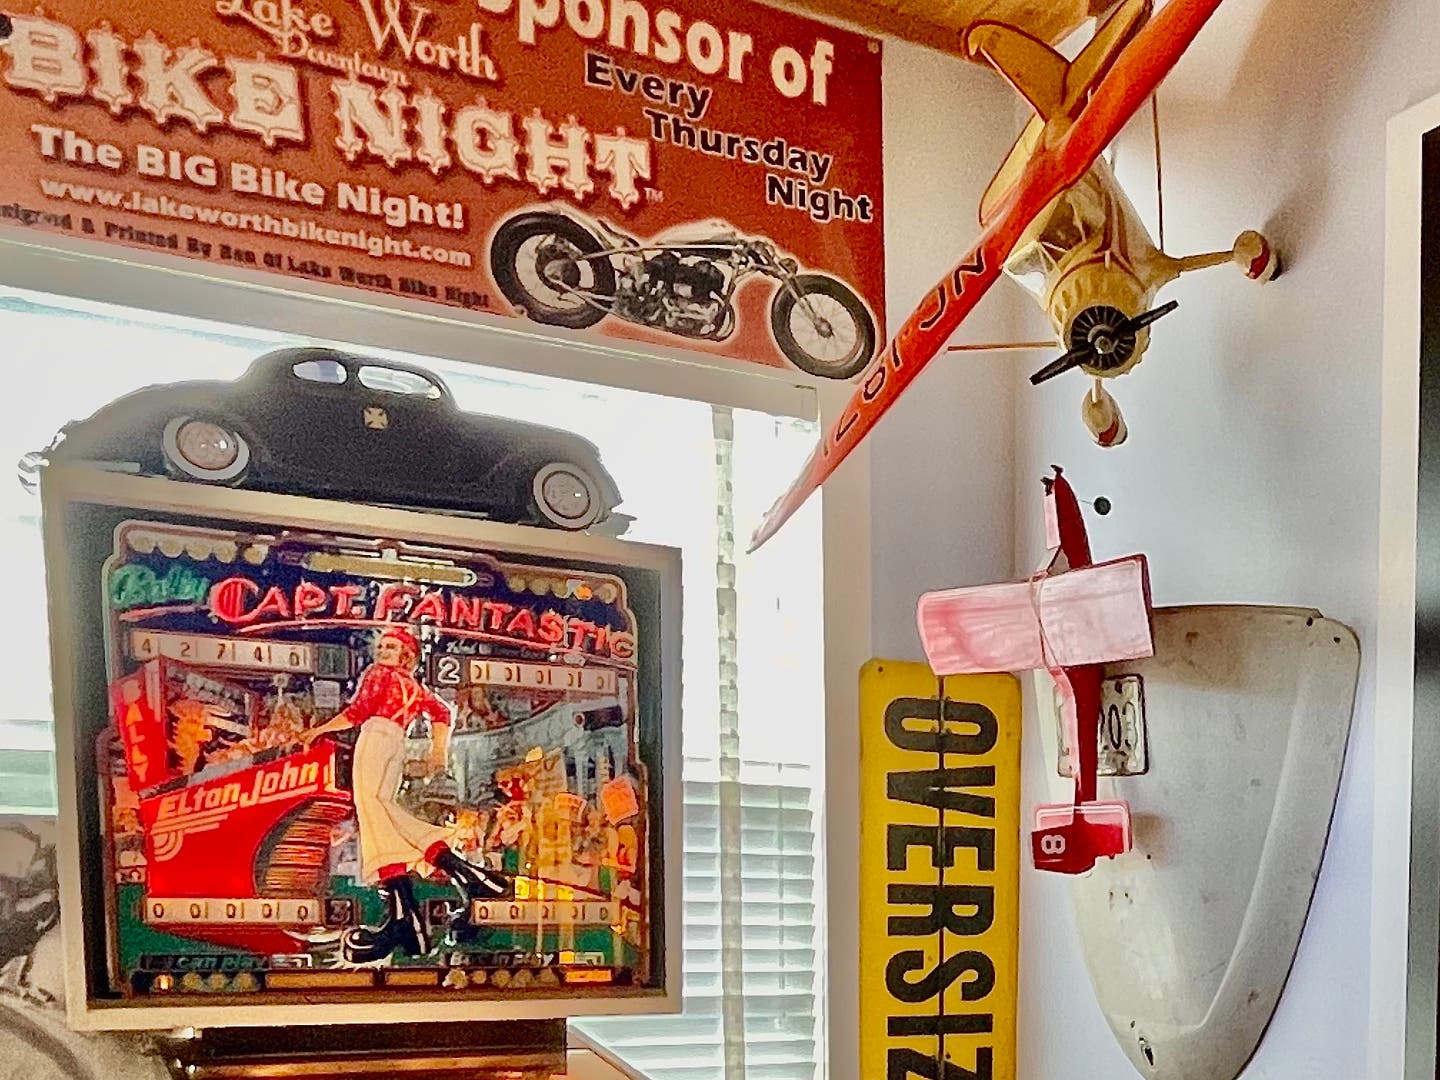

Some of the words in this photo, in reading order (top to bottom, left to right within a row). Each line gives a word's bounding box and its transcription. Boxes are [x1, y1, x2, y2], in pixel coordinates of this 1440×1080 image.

[358, 0, 498, 80] Worth
[477, 0, 753, 83] ponsor
[770, 38, 834, 106] of
[2, 8, 305, 146] BIKE
[330, 74, 651, 210] NIGHT
[585, 52, 712, 119] Every
[31, 124, 122, 169] The
[137, 144, 218, 187] BIG
[231, 162, 325, 206] Bike
[337, 181, 464, 230] Night!
[643, 107, 832, 184] Thursday
[40, 178, 472, 268] www.lakeworthbikenight.com
[765, 174, 873, 223] Night
[207, 576, 366, 624] CAPT.
[373, 580, 636, 660] FANTASTIC
